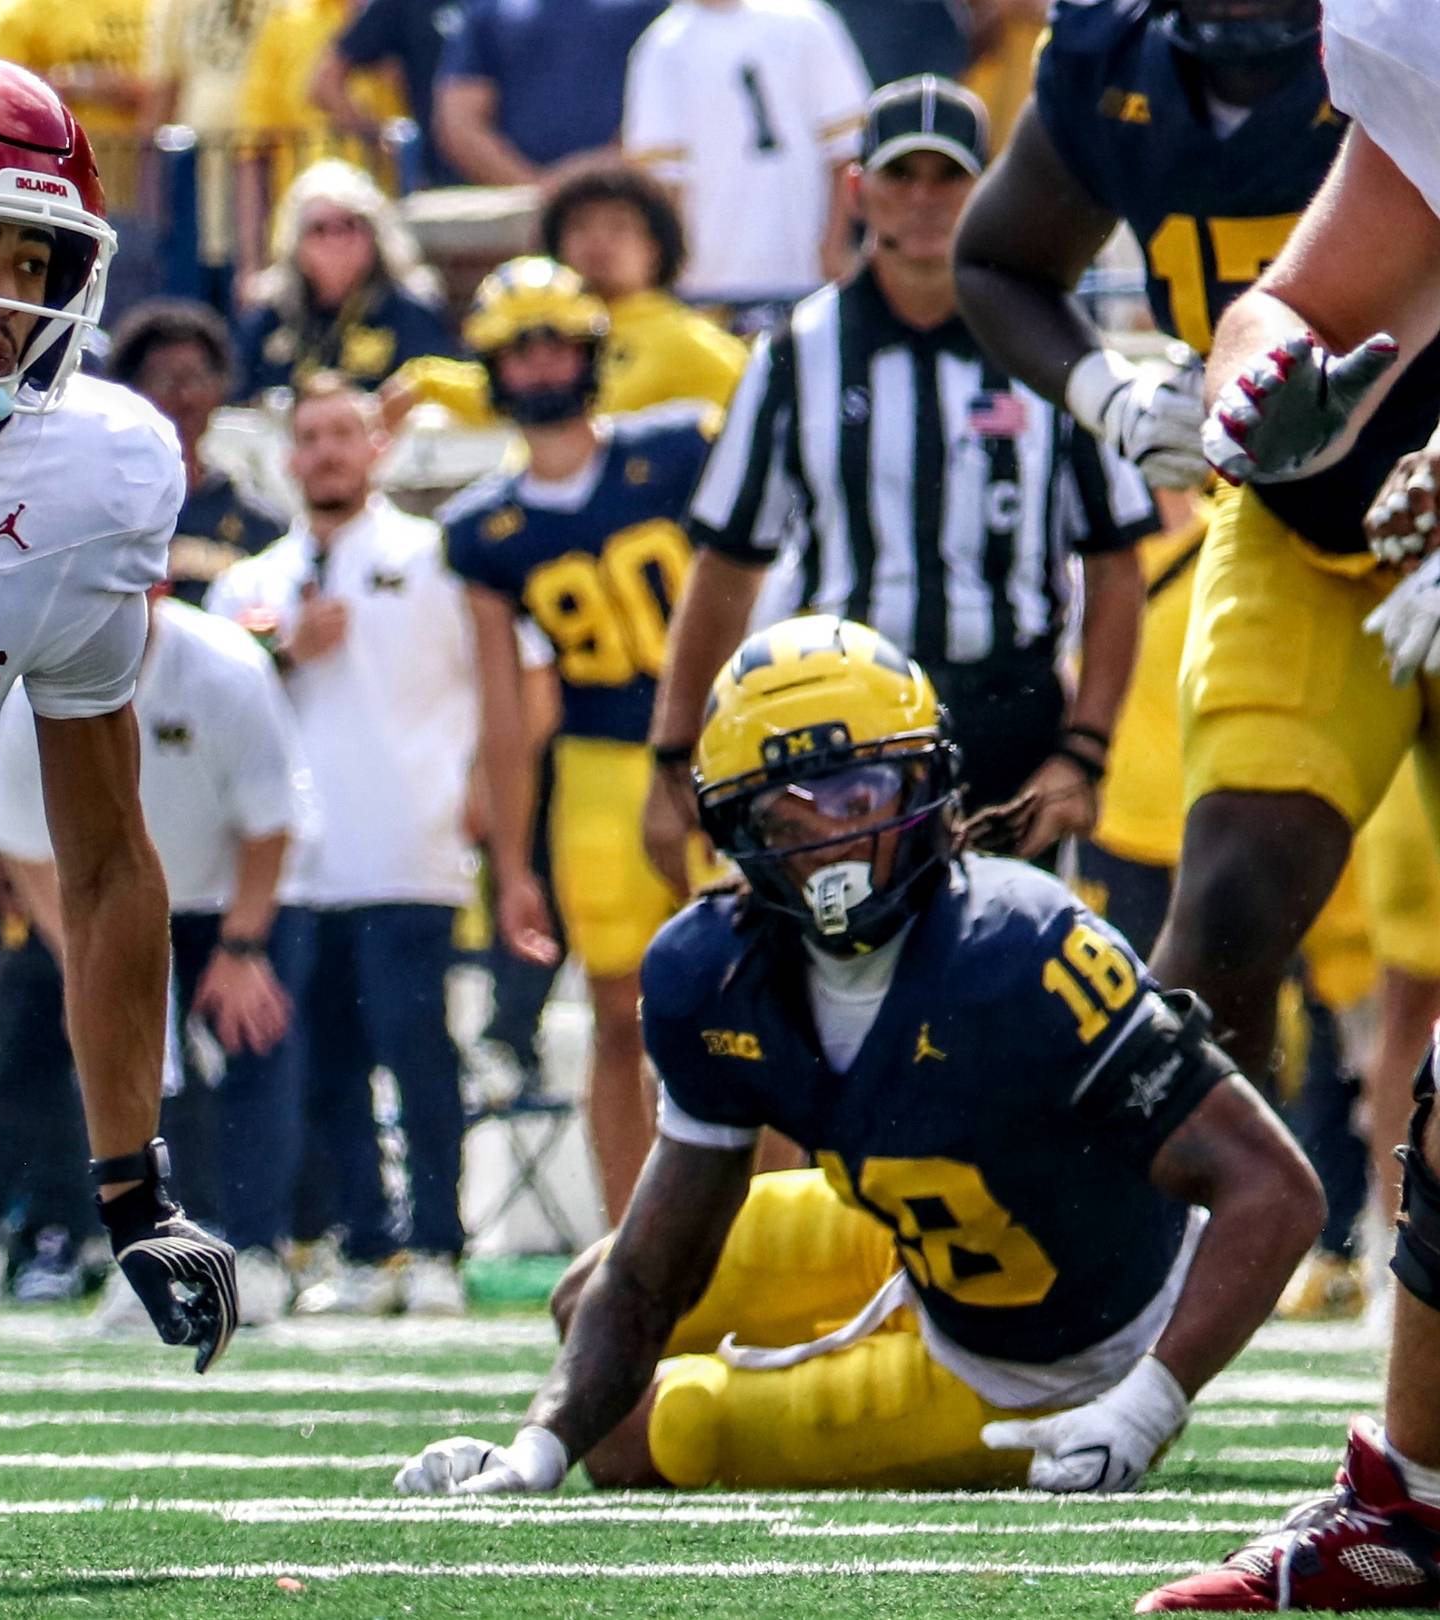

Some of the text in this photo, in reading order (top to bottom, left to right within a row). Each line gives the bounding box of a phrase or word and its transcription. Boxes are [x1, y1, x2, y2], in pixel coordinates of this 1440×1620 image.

[15, 176, 68, 198] OKLAHOMA
[523, 517, 696, 688] 90
[1041, 923, 1137, 1046] 18
